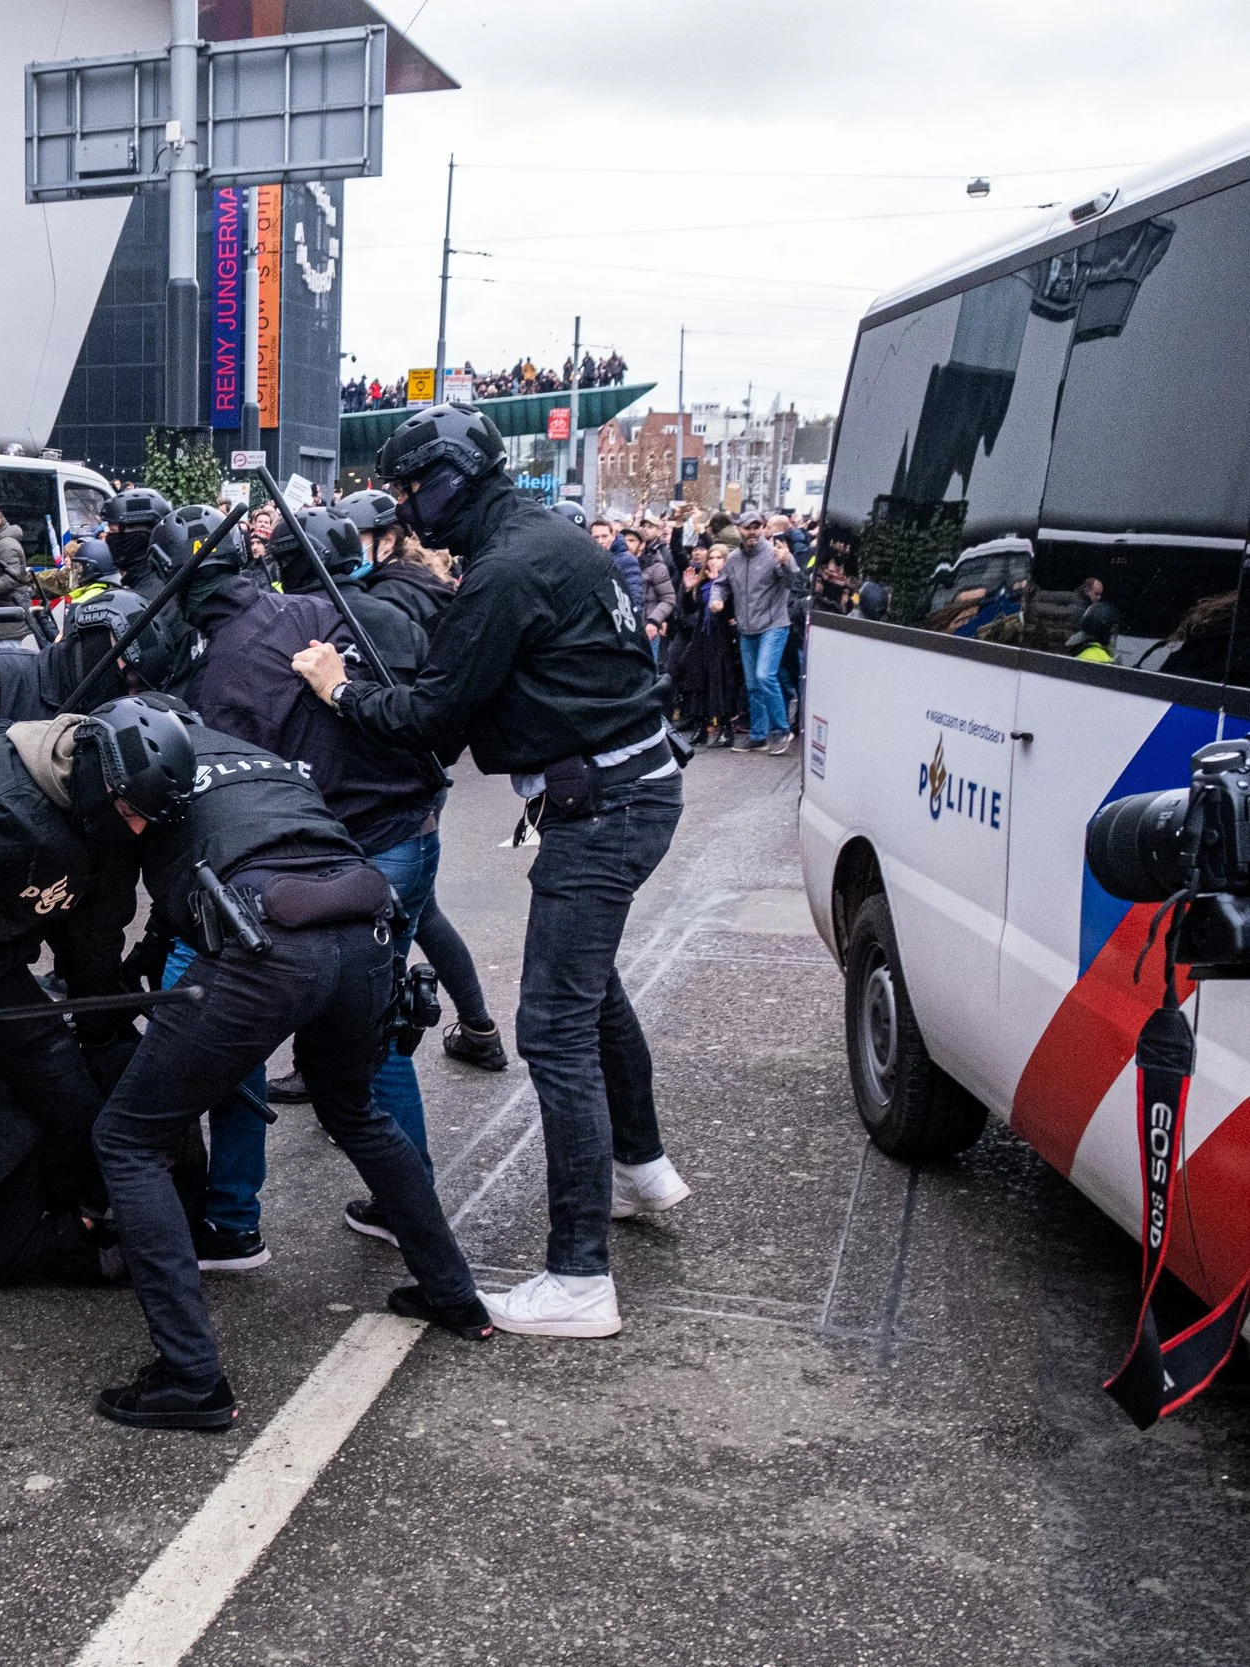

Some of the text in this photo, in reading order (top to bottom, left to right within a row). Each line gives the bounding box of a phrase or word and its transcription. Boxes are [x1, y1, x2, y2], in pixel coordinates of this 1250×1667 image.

[216, 338, 236, 411] REMY
[269, 383, 277, 424] collection
[192, 760, 312, 792] OLITIE
[919, 755, 1002, 829] POLITIE
[1150, 1102, 1173, 1248] EOS 80D
